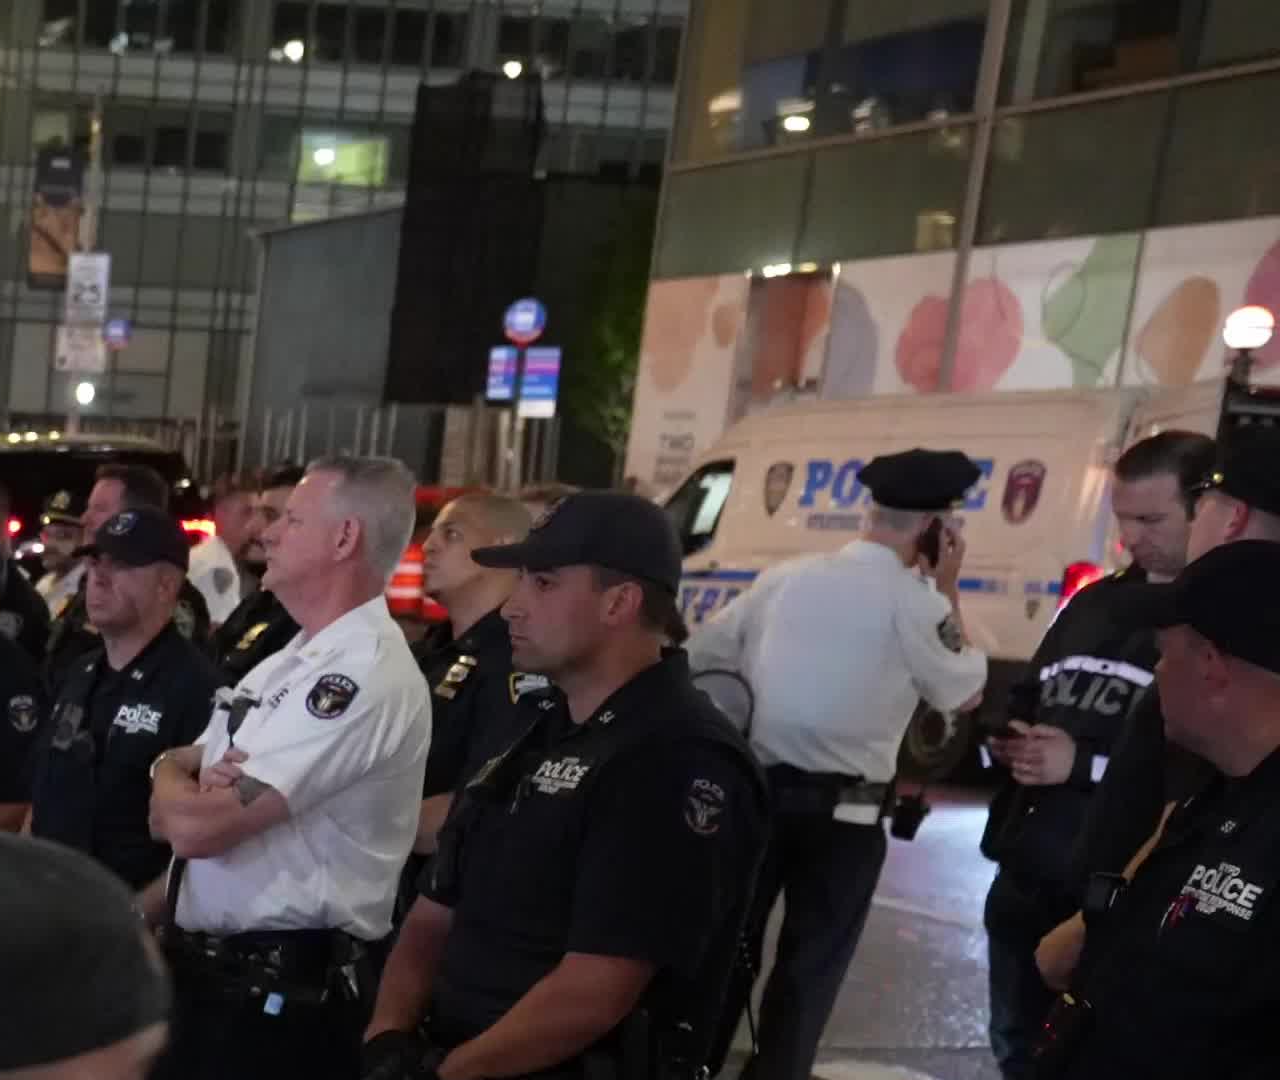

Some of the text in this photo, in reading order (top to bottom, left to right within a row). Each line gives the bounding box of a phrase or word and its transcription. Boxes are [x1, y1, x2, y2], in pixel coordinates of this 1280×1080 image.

[114, 704, 164, 727] POLICE
[535, 760, 592, 783] POLICE
[1186, 863, 1265, 910] POLICE
